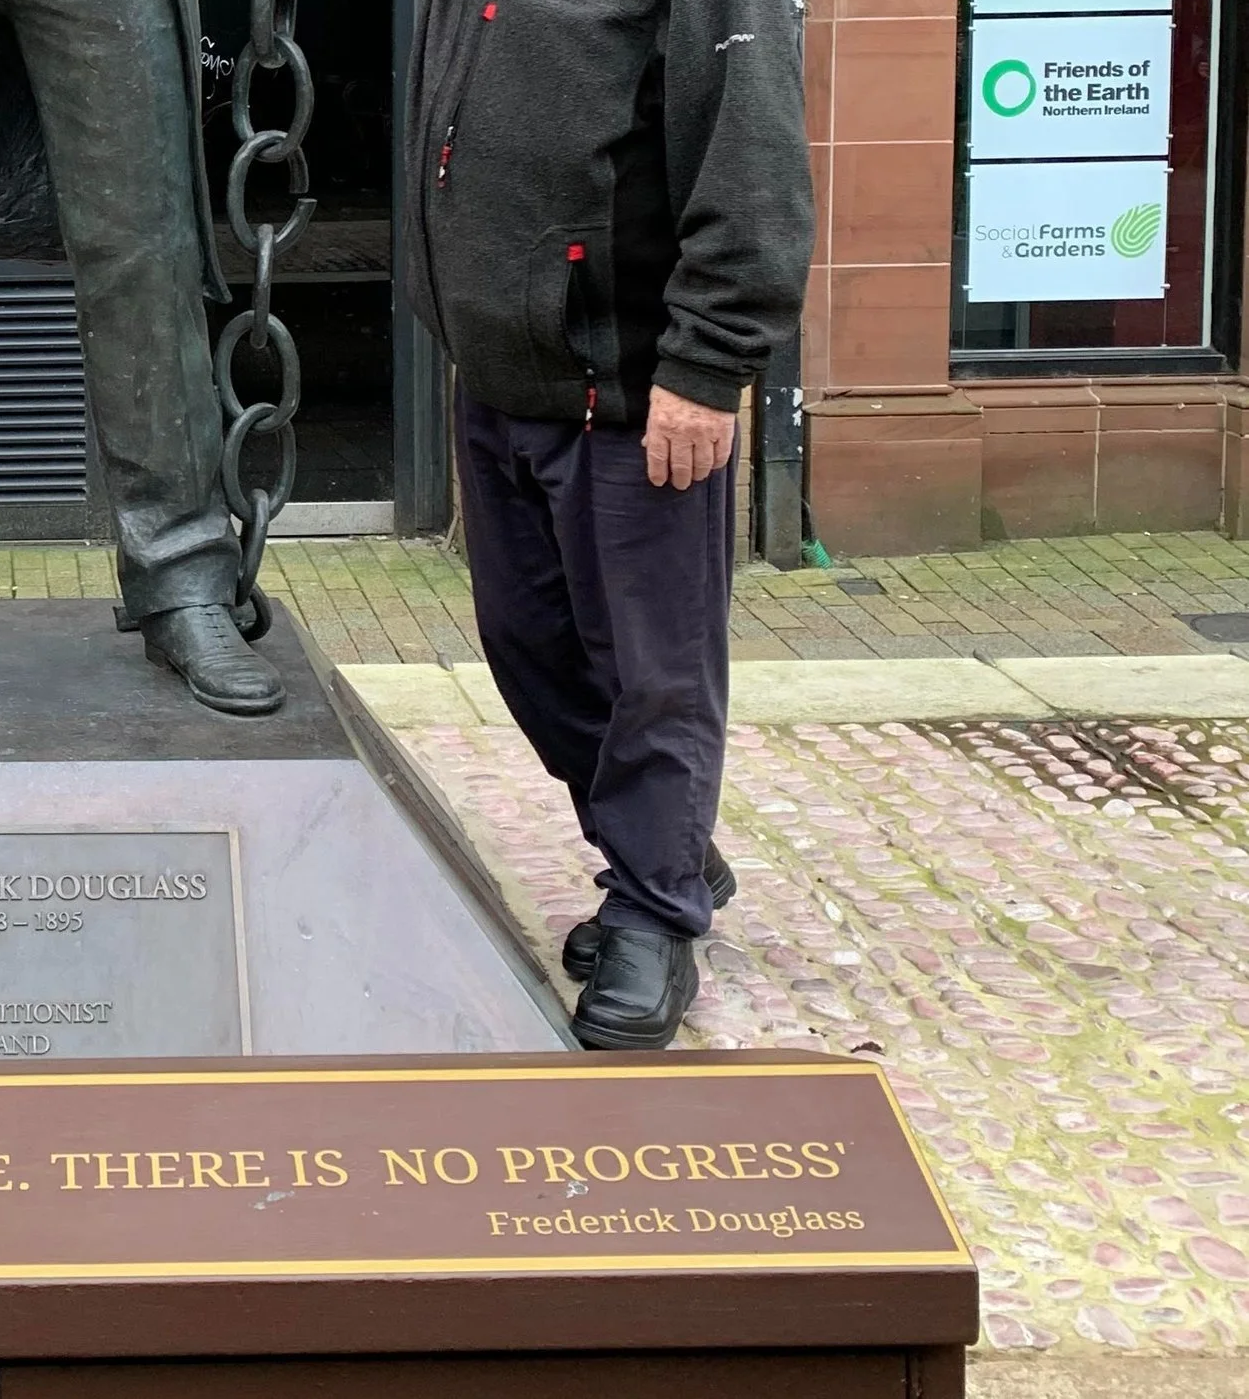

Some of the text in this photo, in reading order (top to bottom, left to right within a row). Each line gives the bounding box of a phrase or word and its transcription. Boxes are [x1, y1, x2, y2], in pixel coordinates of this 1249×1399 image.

[1044, 59, 1151, 78] Friends of
[1044, 82, 1150, 102] the Earth
[1042, 103, 1150, 116] Northern Ireland
[27, 873, 208, 901] DOUGLASS
[34, 910, 84, 933] 1895
[50, 1151, 271, 1190] THERE
[286, 1149, 349, 1187] IS
[379, 1147, 480, 1186] NO
[495, 1141, 846, 1183] PROGRESS'
[486, 1205, 866, 1238] Frederick Douglass
